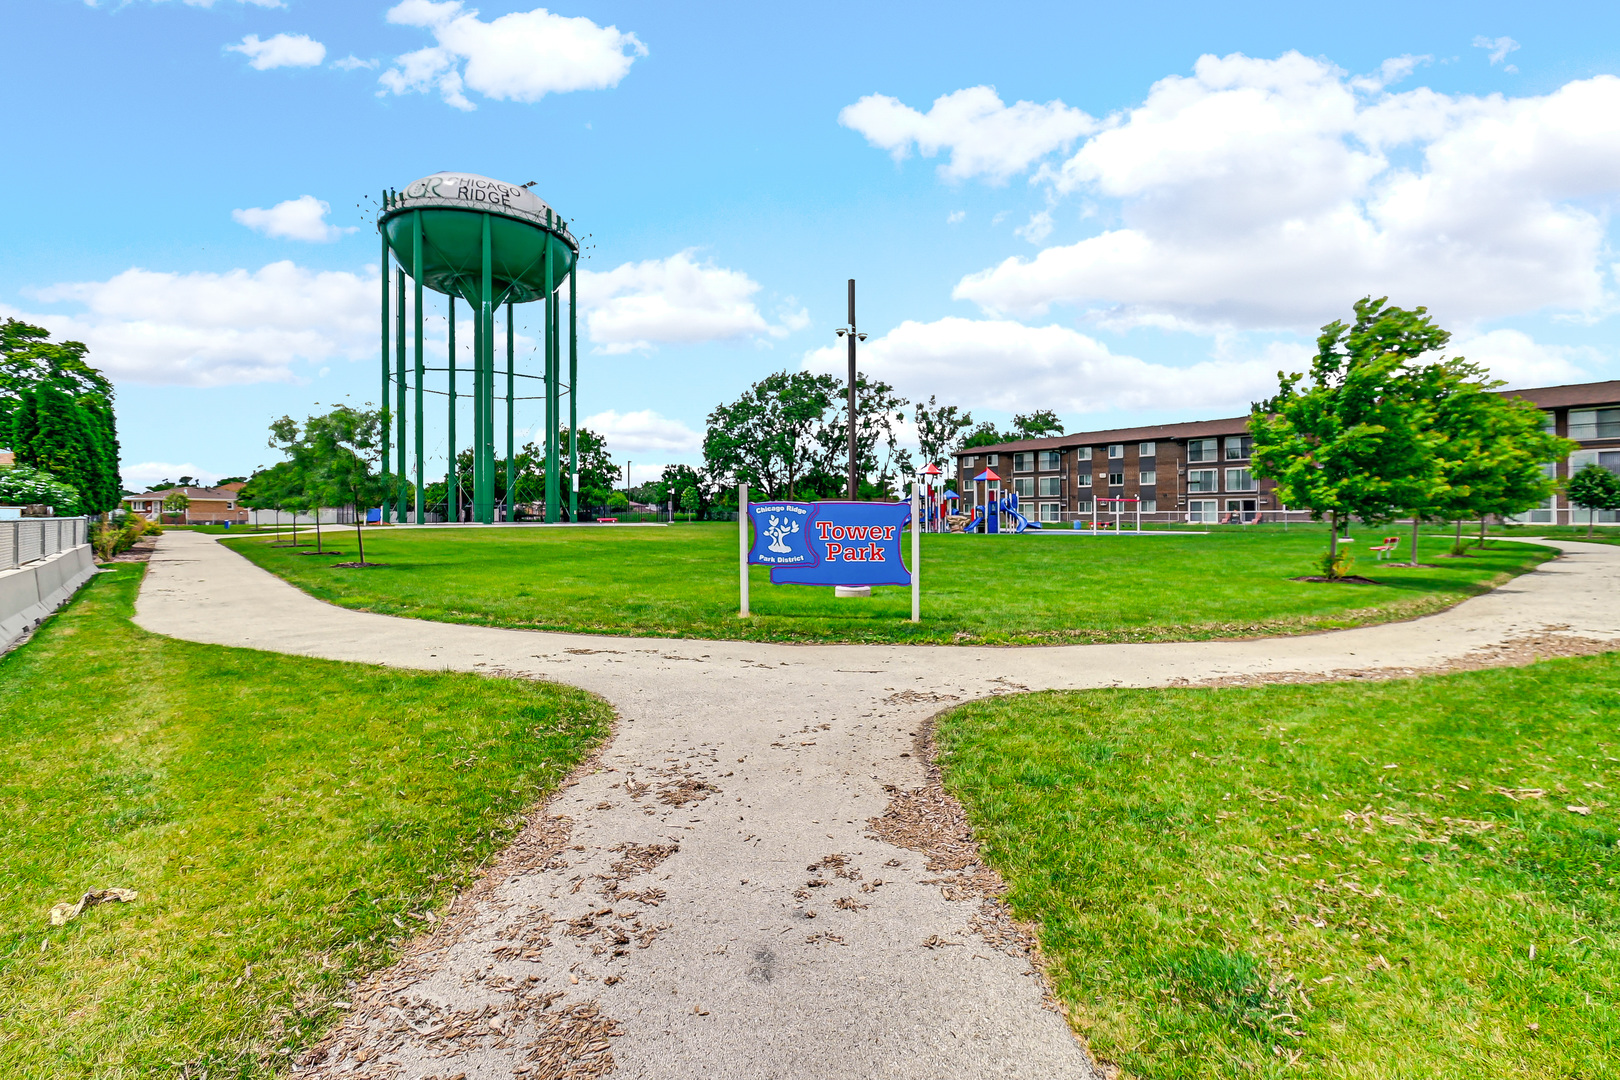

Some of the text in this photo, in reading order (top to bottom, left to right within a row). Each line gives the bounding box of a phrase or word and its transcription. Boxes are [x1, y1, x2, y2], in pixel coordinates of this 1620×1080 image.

[458, 186, 511, 208] RIDGE
[755, 505, 807, 514] Chicago Ridge
[815, 521, 896, 541] Tower
[759, 555, 804, 563] Park District
[825, 542, 886, 562] Park
